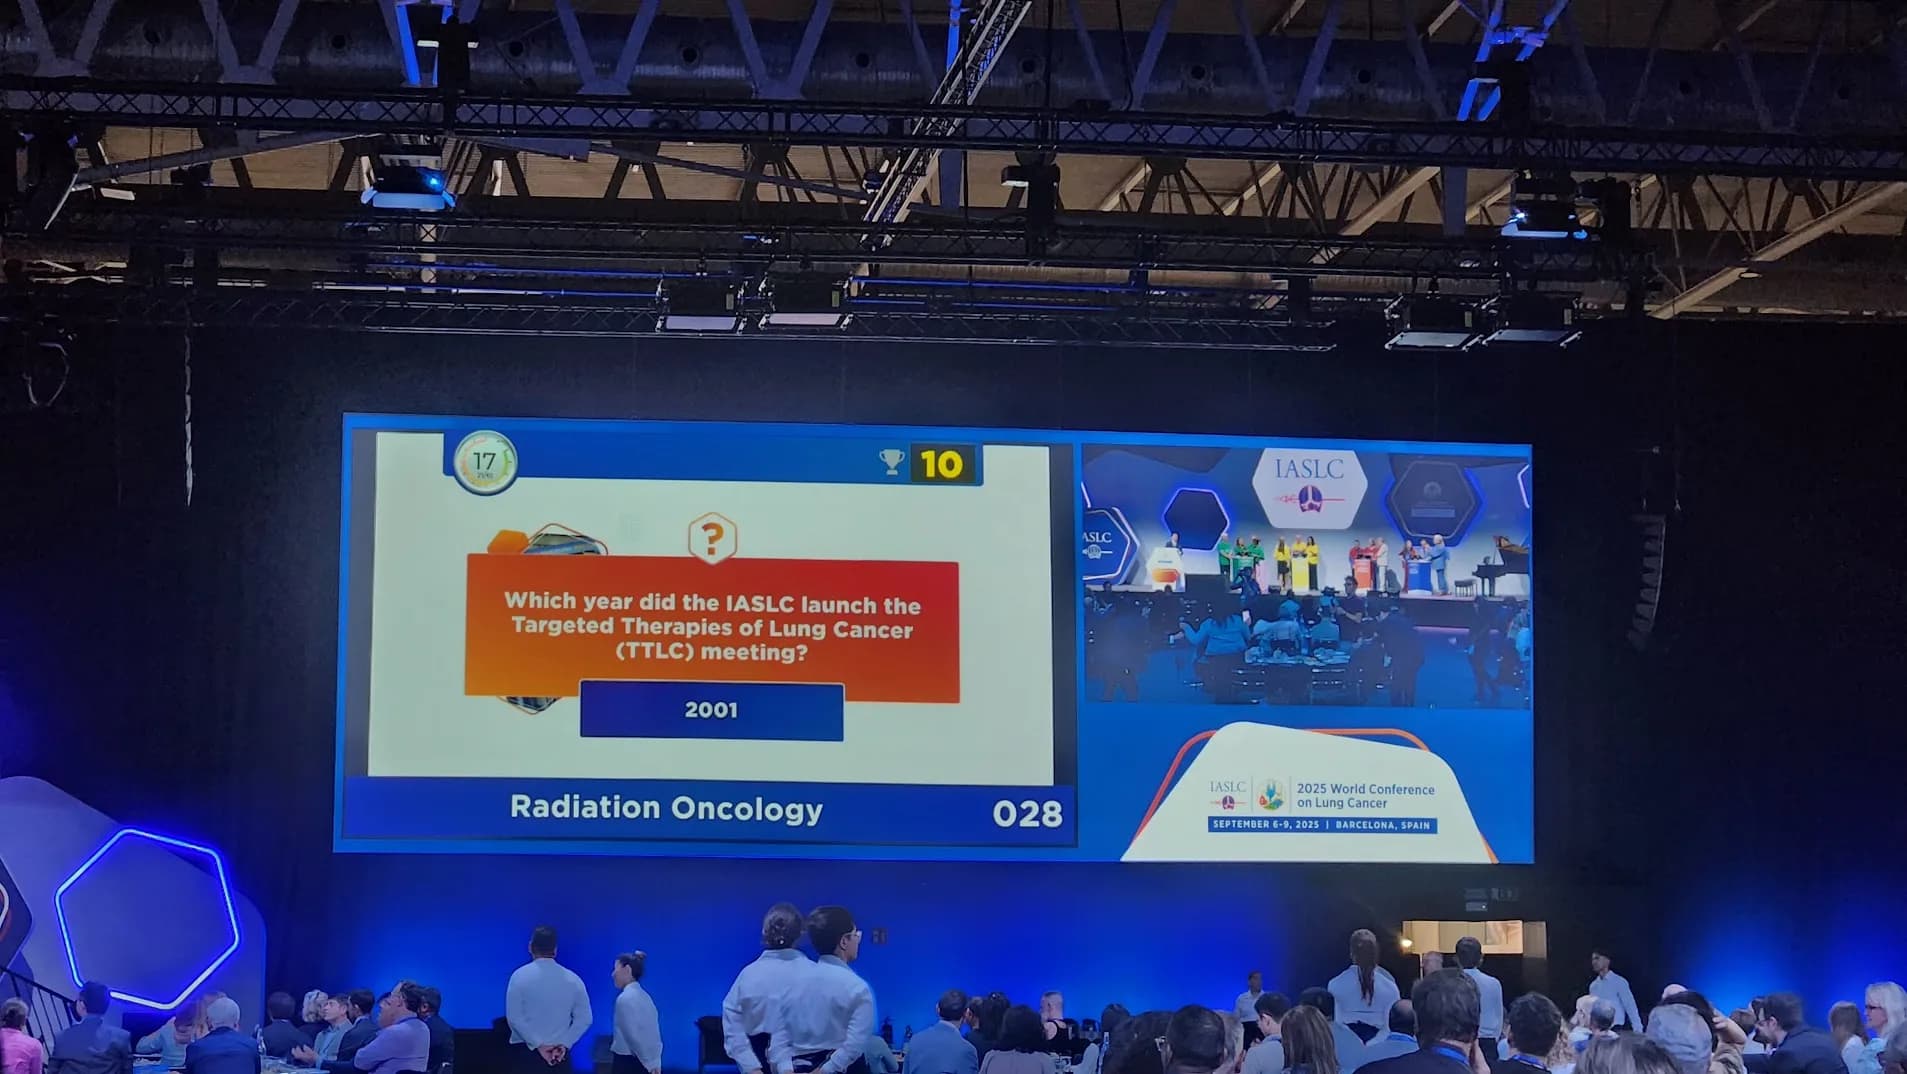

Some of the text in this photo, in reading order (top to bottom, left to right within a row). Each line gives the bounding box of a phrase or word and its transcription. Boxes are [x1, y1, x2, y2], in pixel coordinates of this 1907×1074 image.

[473, 452, 497, 470] 17
[921, 450, 963, 478] 10
[1275, 458, 1344, 479] IASLC
[504, 591, 921, 615] Which year did the IASLC launch the
[511, 615, 914, 640] Targeted Therapies of Lung Cancer
[615, 641, 808, 664] (TTLC) meeting?
[685, 701, 738, 718] 2001
[1208, 780, 1247, 793] IASLC
[1297, 783, 1436, 796] 2025 World Conference
[511, 793, 823, 827] Radiation Oncology
[993, 800, 1063, 828] 028
[1297, 797, 1388, 810] on Lung Cancer
[1213, 819, 1270, 829] SEPTEMBER
[1272, 820, 1293, 830] 6-9,
[1295, 820, 1320, 829] 2025
[1336, 820, 1398, 831] BARCELONA,
[1401, 821, 1431, 830] SPAIN
